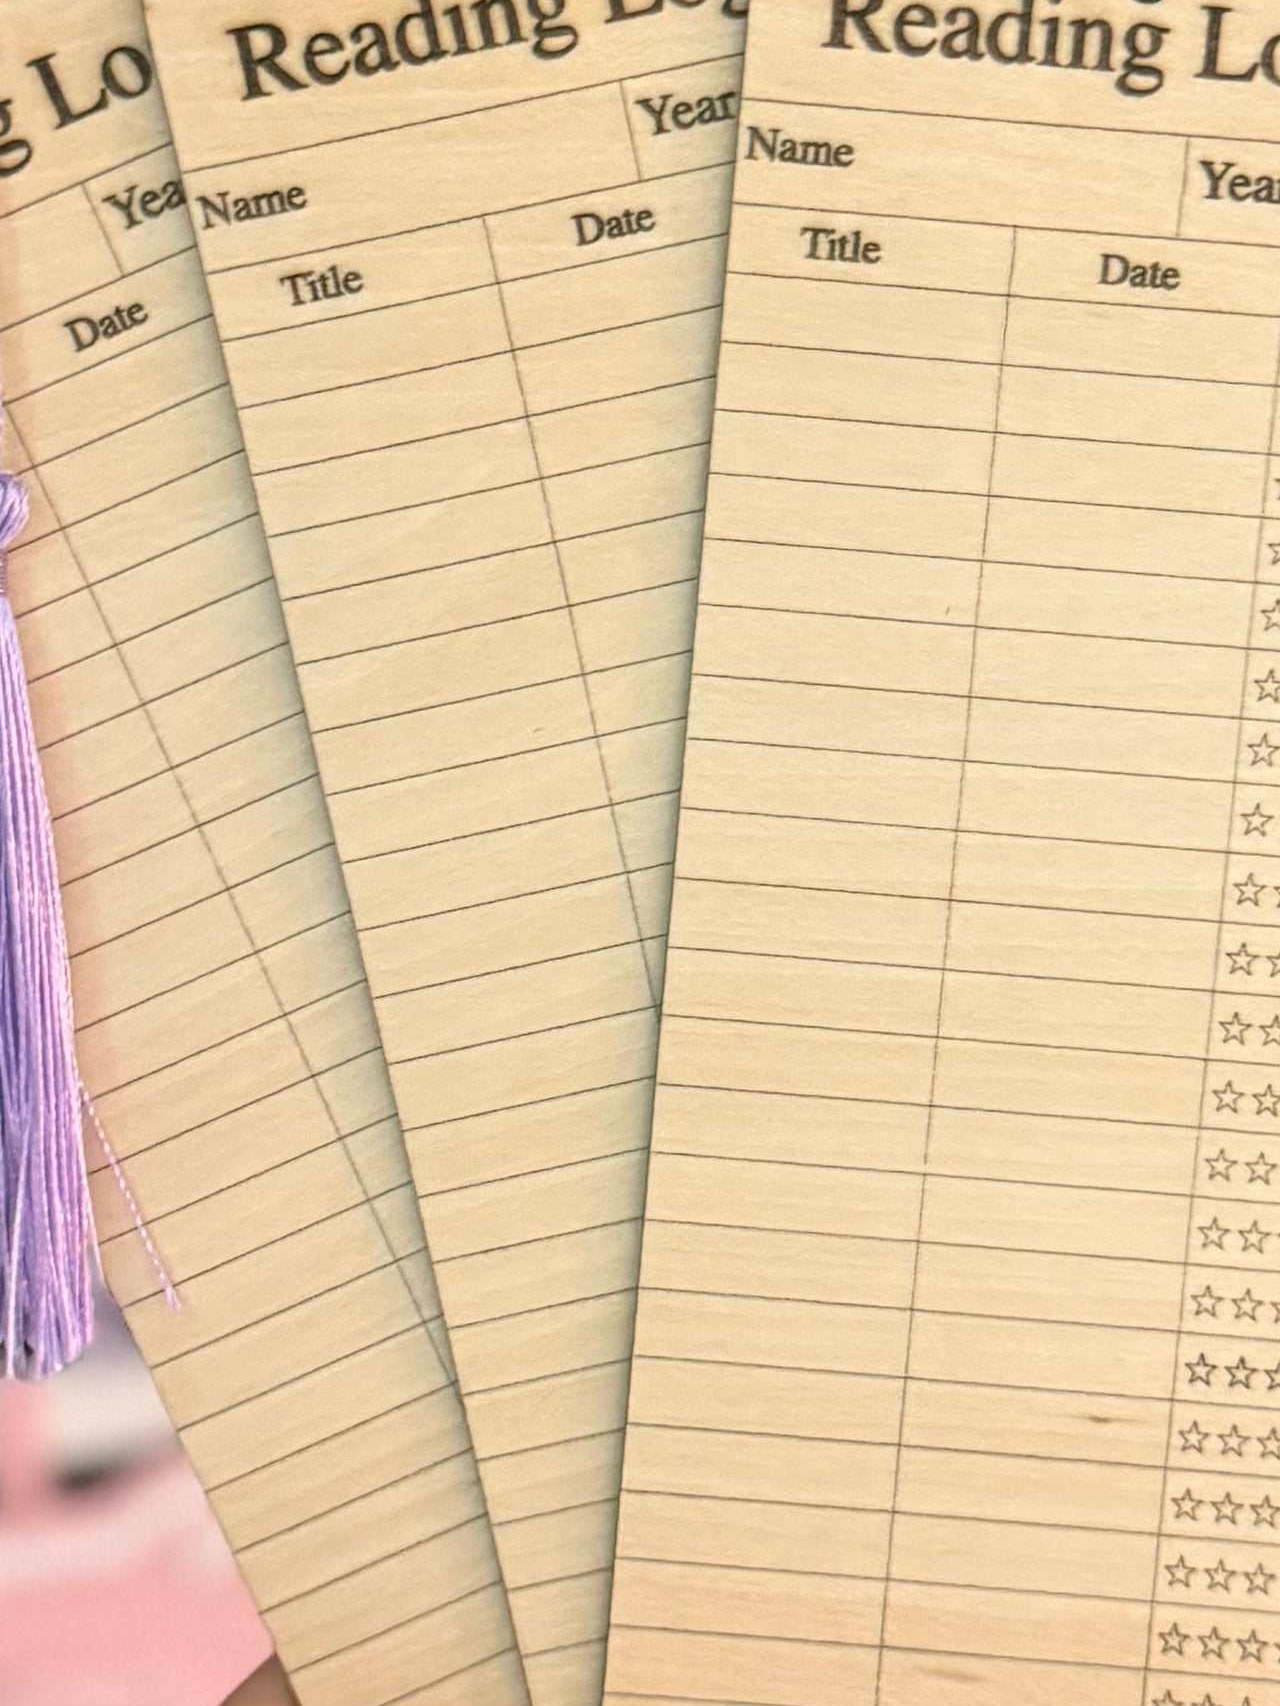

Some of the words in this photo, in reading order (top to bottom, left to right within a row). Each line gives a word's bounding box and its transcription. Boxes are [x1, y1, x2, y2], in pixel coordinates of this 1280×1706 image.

[26, 41, 152, 130] Lo
[636, 89, 736, 137] Year
[745, 125, 855, 169] Name
[101, 175, 186, 230] Yea
[195, 179, 308, 230] Name
[571, 204, 657, 248] Date
[801, 225, 882, 266] Title
[279, 266, 364, 308] Title
[1098, 252, 1181, 291] Date
[64, 297, 149, 352] Date
